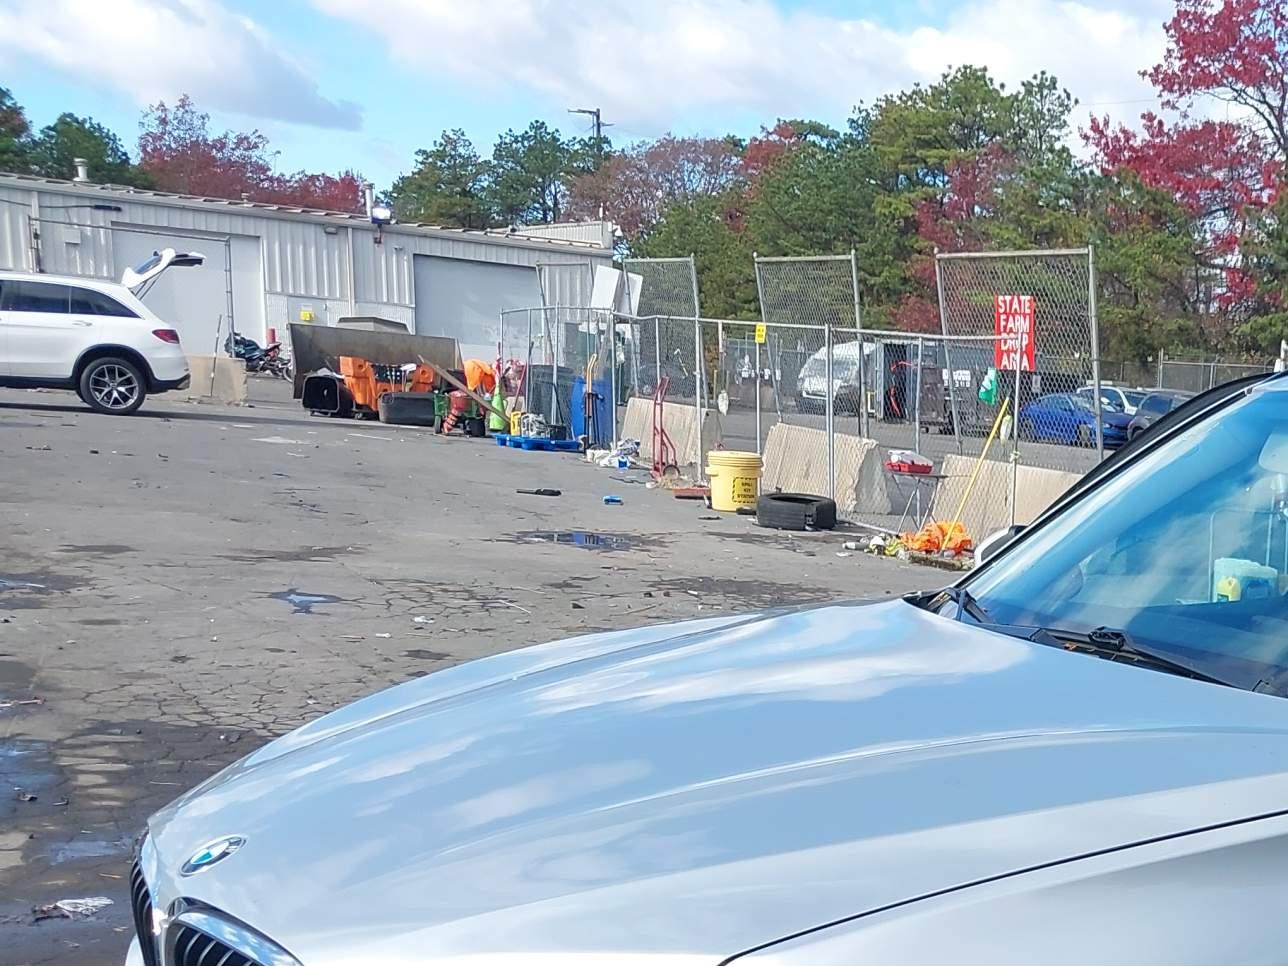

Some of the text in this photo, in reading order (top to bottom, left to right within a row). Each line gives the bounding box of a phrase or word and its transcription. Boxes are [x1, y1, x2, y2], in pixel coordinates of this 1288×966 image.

[998, 295, 1031, 313] STATE
[1000, 314, 1029, 333] FARM
[1000, 352, 1030, 371] ARA
